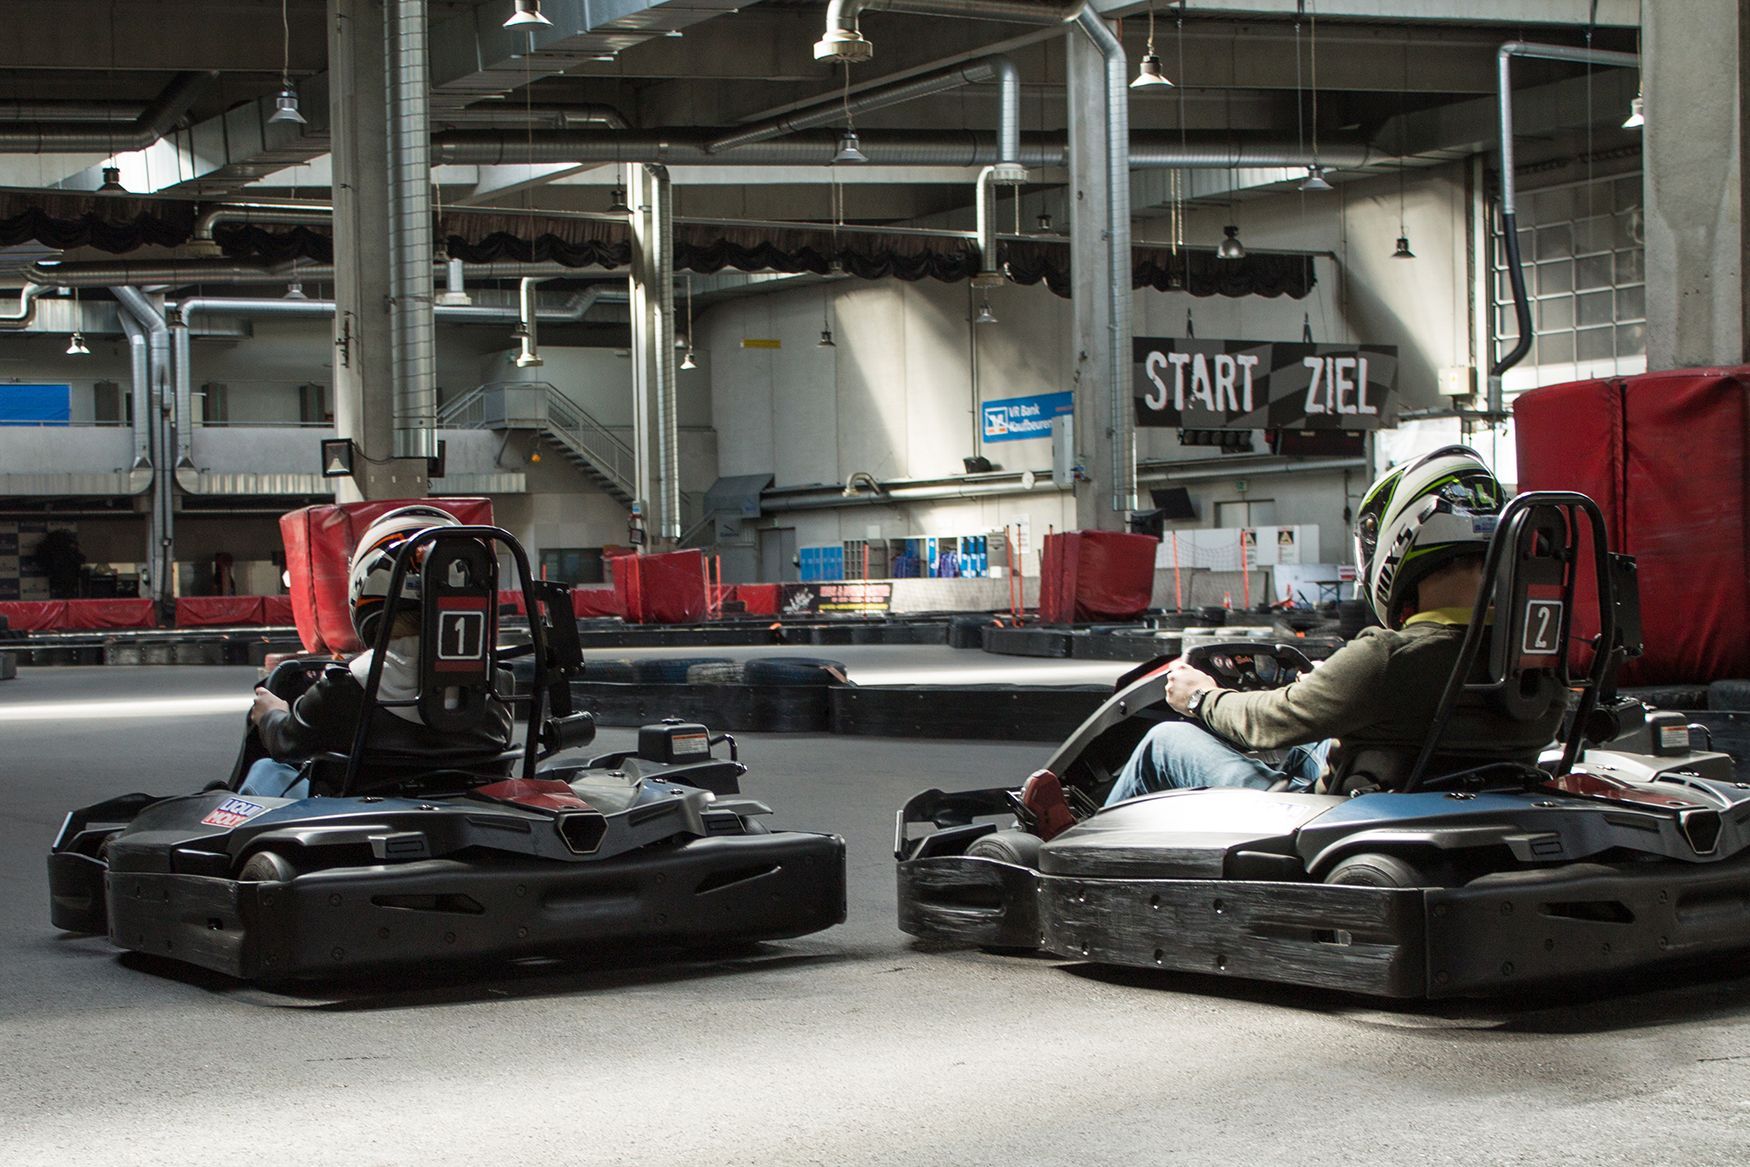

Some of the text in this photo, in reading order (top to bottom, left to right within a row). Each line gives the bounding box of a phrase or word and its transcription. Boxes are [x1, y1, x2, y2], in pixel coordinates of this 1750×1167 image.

[1144, 351, 1377, 415] START ZIEL
[1008, 405, 1020, 417] VR
[1020, 403, 1040, 417] Bank
[454, 616, 465, 655] 1
[1535, 606, 1550, 648] 2
[204, 809, 250, 828] MOLY
[219, 798, 264, 817] LIQUI
